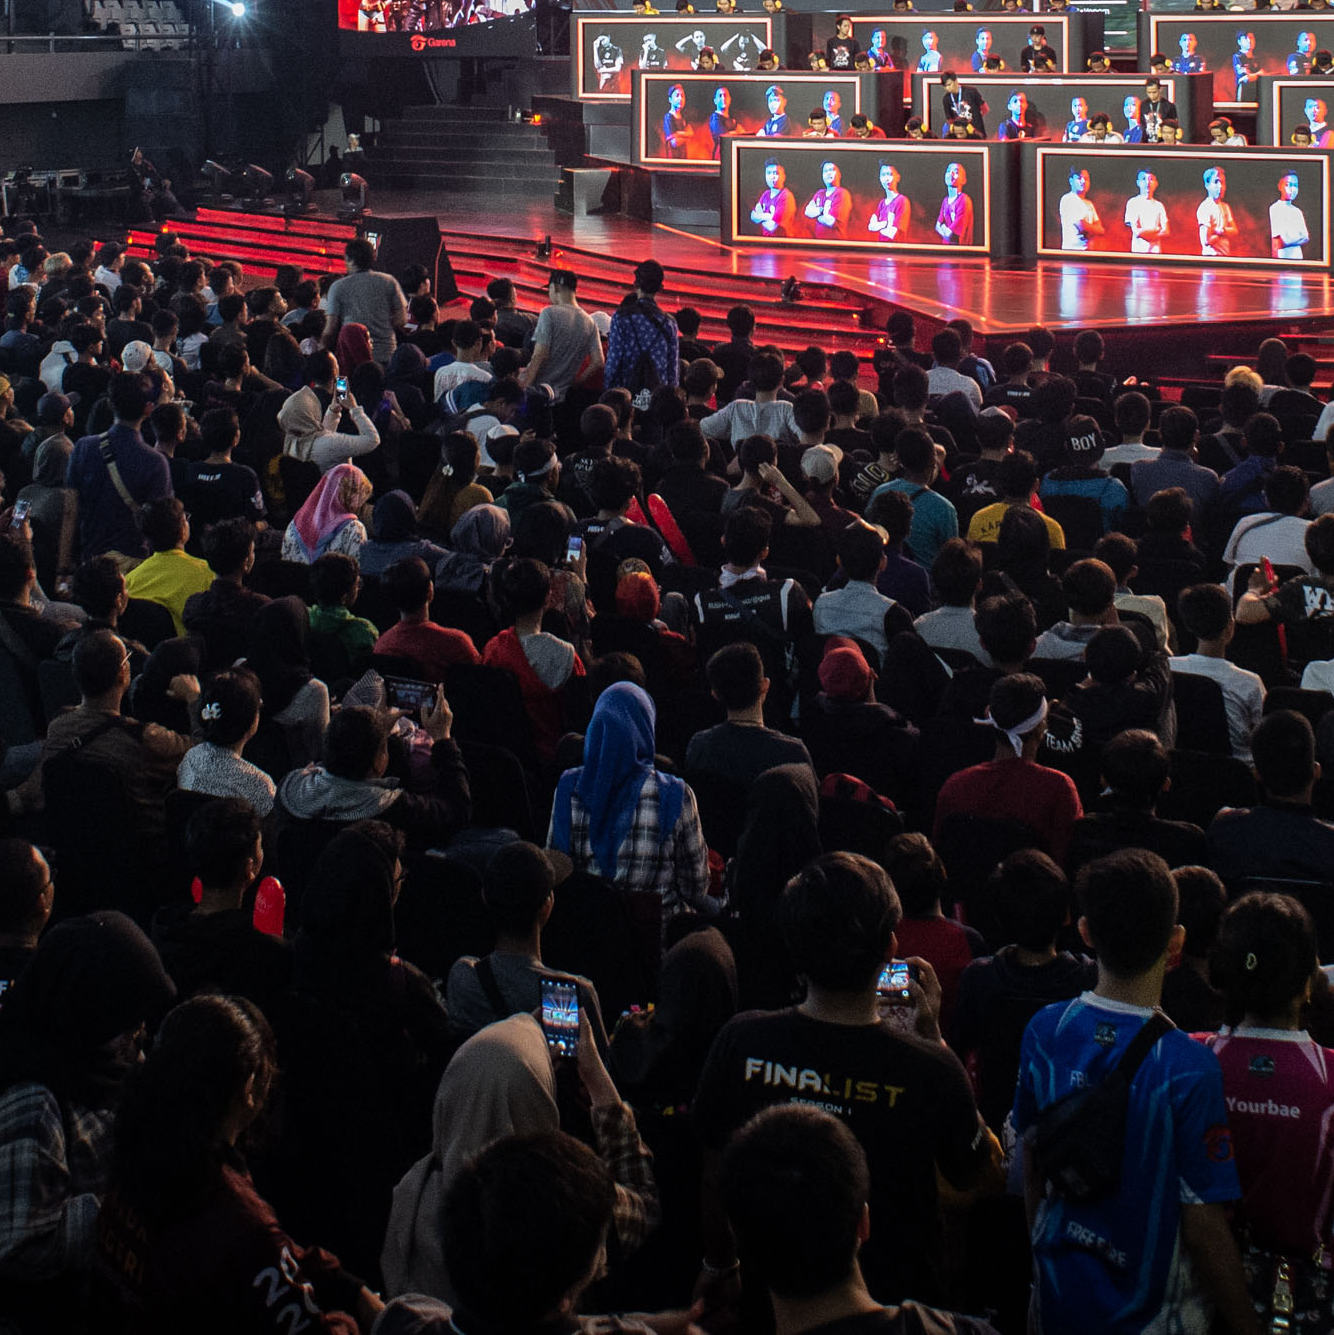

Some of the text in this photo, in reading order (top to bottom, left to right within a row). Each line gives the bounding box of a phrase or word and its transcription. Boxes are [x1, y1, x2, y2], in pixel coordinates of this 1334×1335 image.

[427, 37, 456, 48] Garena
[1070, 432, 1097, 451] BOY
[1046, 732, 1075, 753] TEAM
[744, 1056, 906, 1109] FINALIST
[1226, 1096, 1301, 1120] Yourbae
